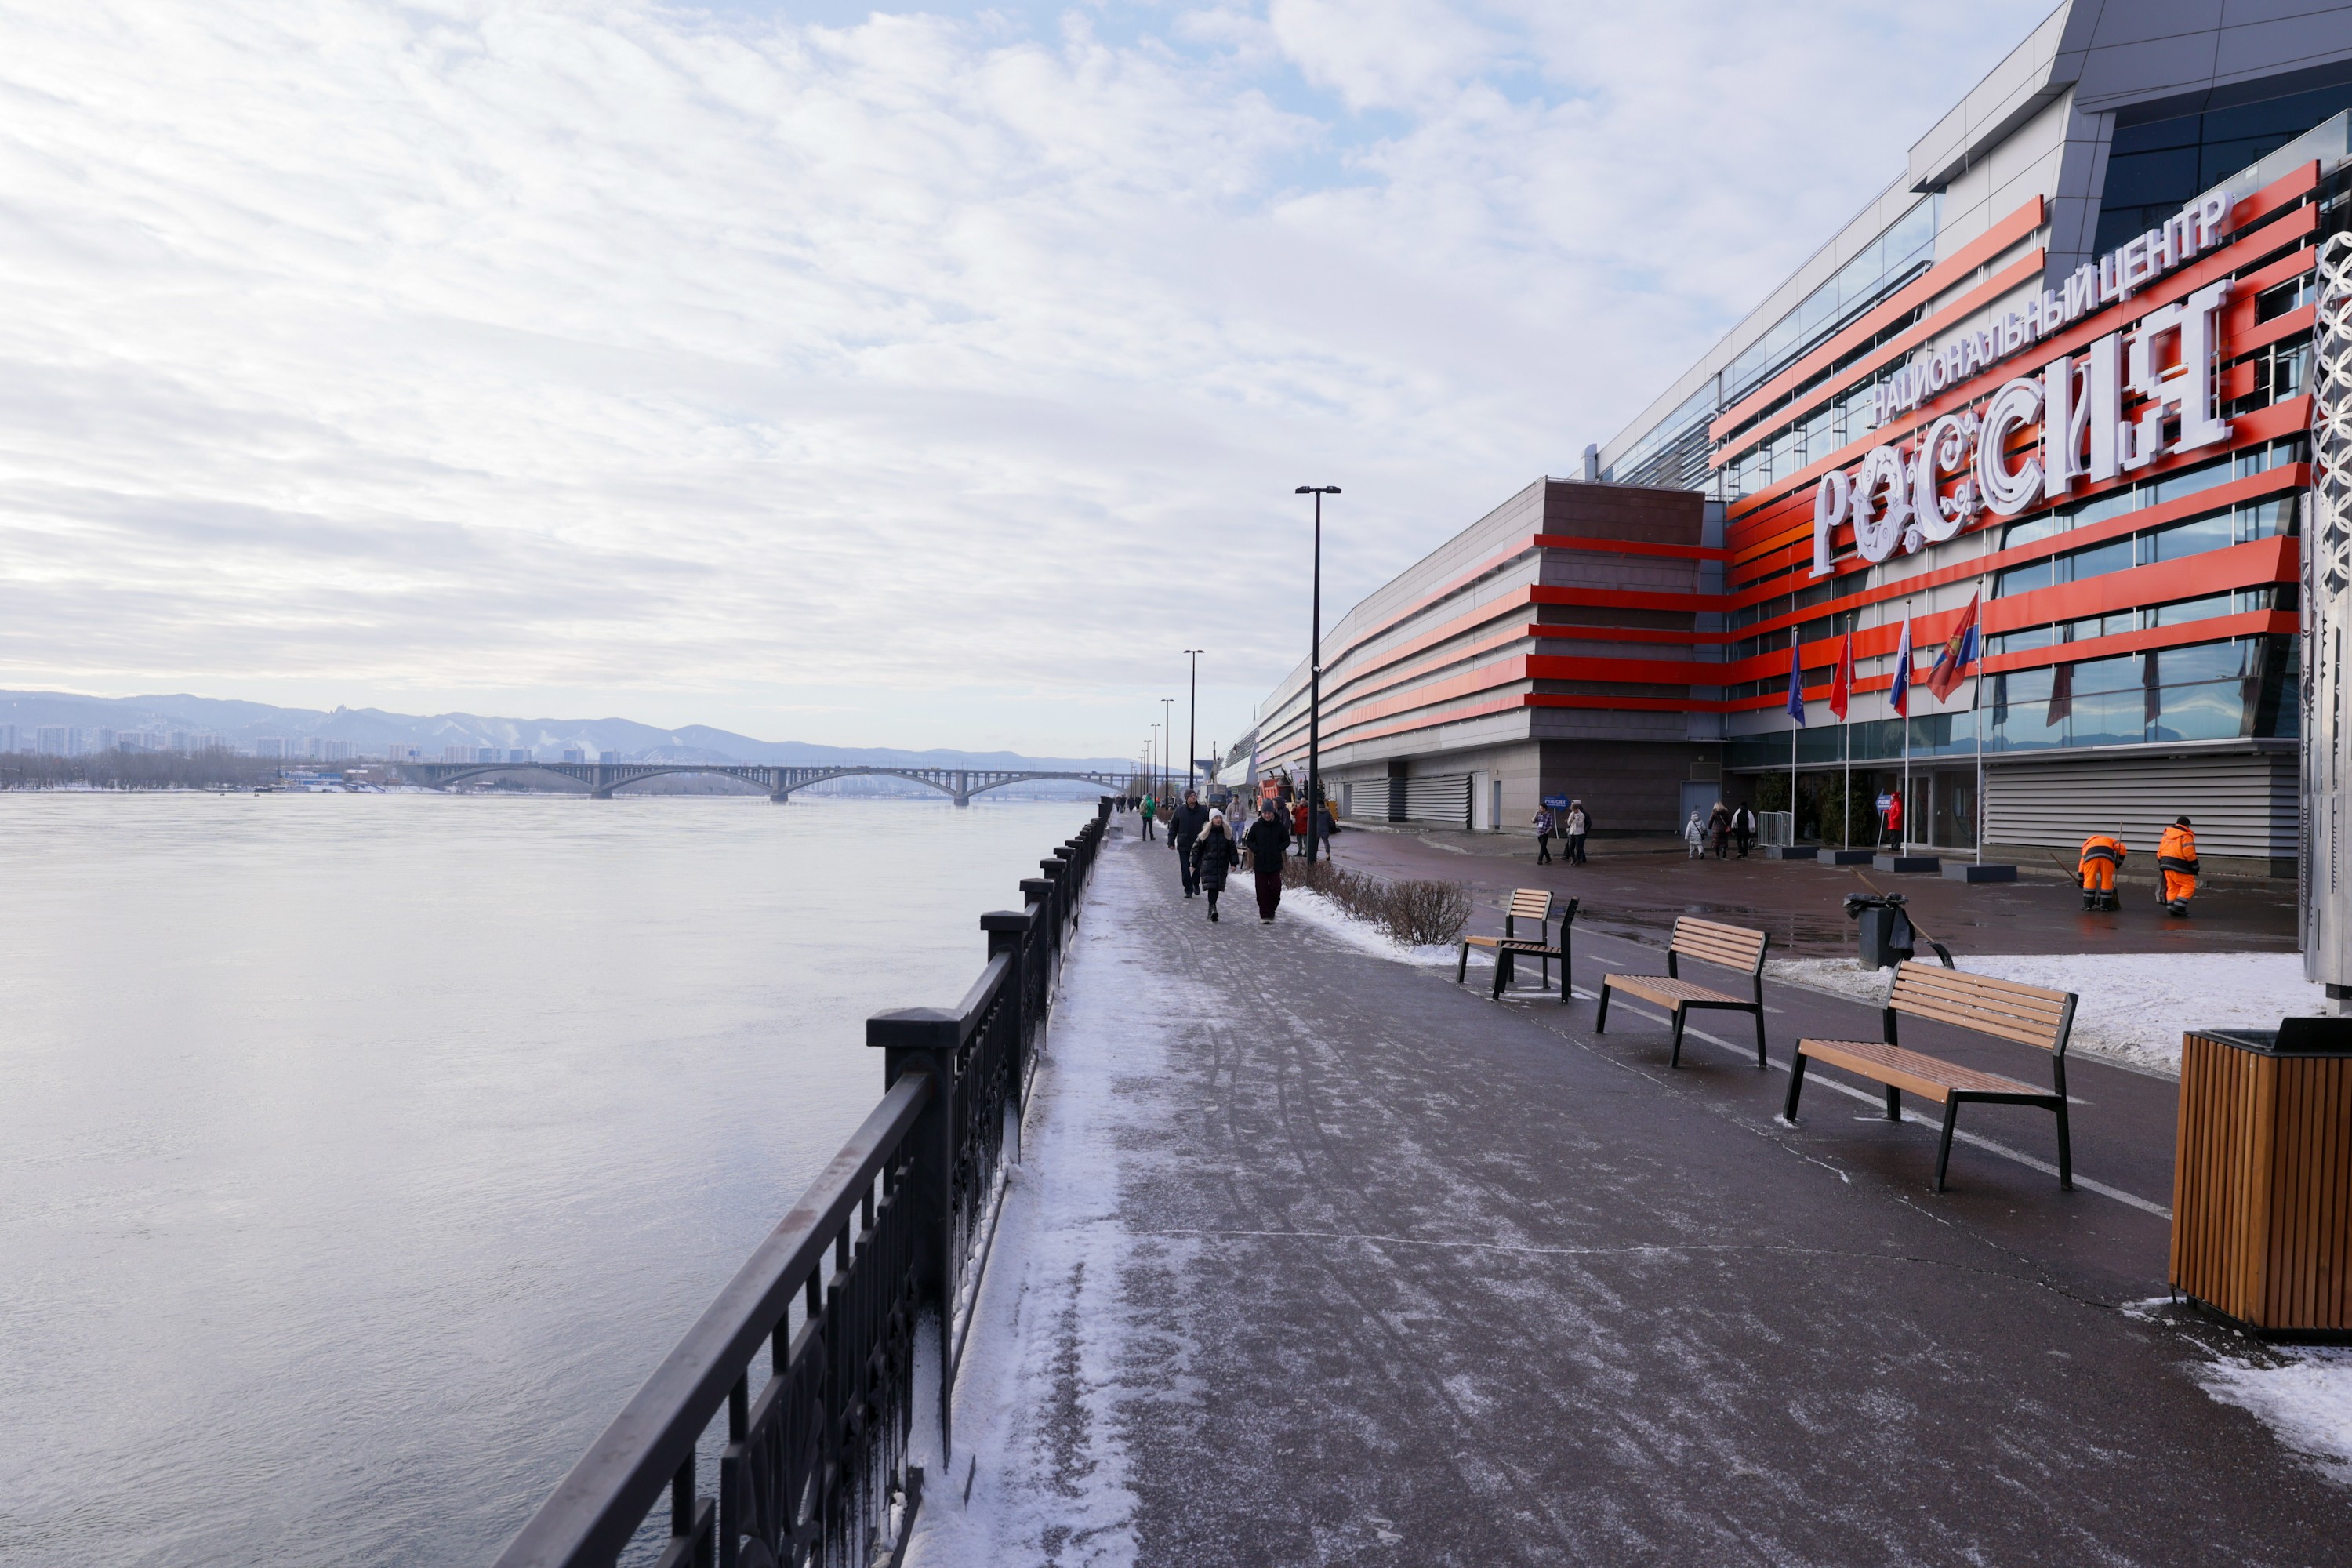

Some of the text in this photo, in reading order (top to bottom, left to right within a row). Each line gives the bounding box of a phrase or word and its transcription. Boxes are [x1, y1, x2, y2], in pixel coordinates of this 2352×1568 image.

[1809, 279, 2233, 578] РОССИЯ
[1872, 191, 2234, 423] НАЦИОНАЛЬНЫЙ ЦЕНТР
